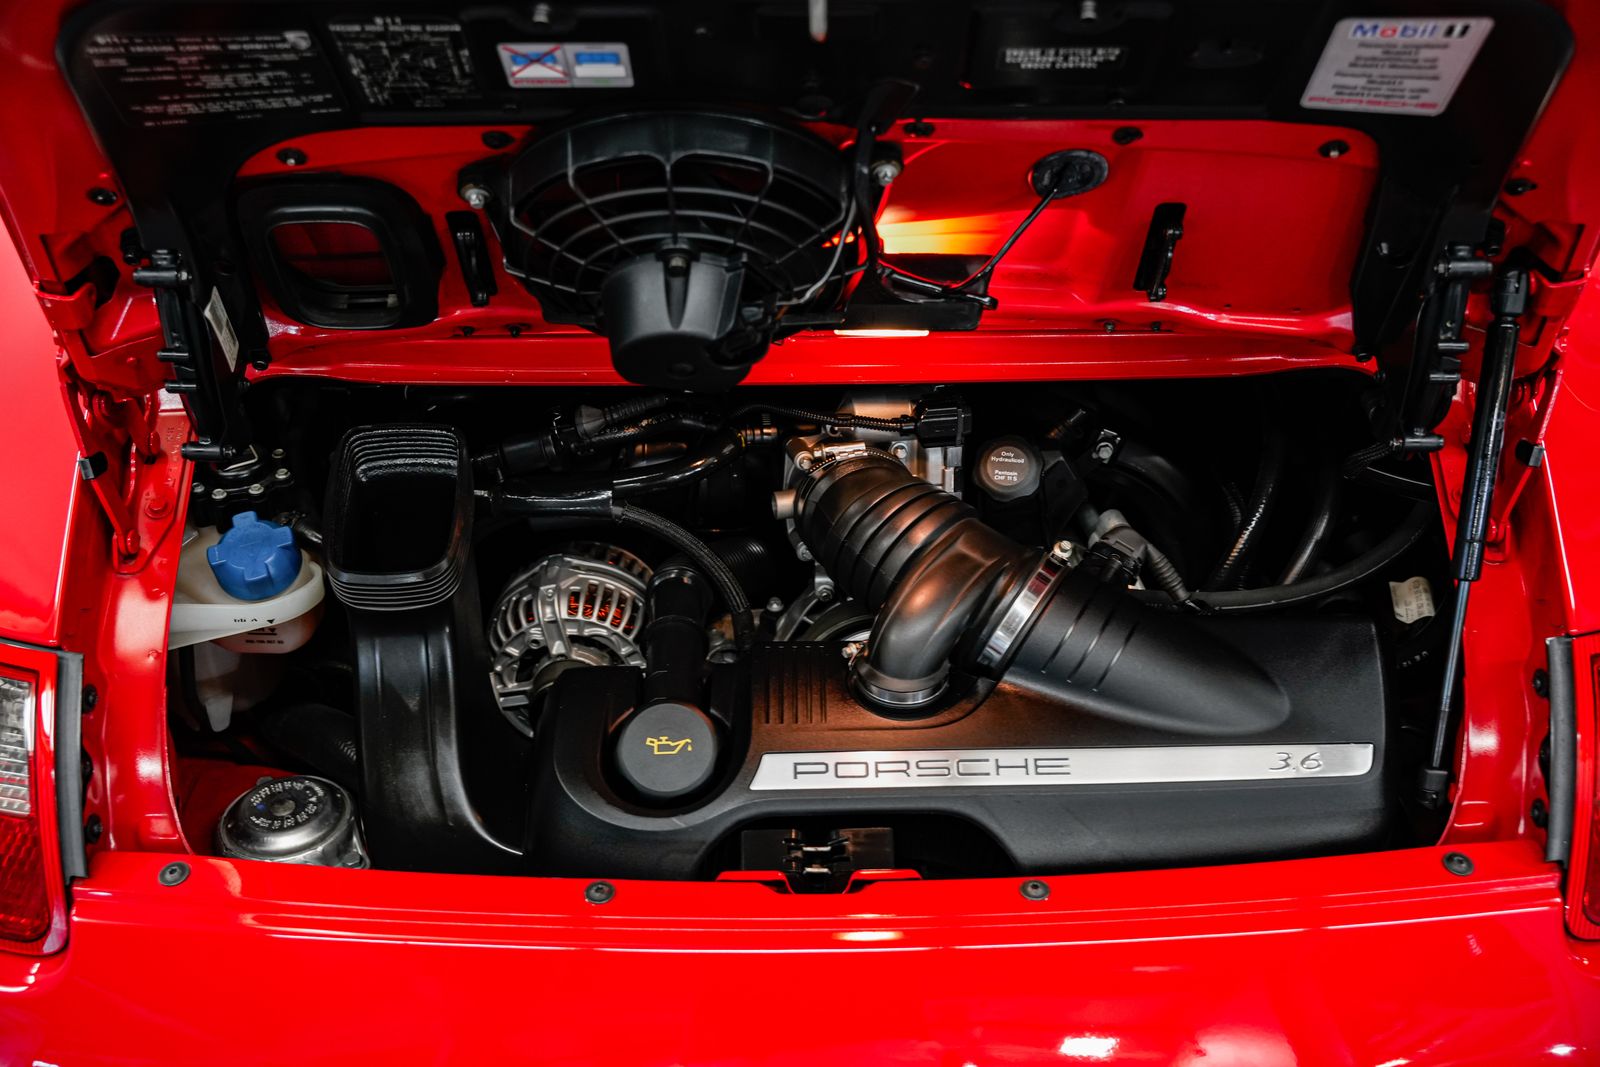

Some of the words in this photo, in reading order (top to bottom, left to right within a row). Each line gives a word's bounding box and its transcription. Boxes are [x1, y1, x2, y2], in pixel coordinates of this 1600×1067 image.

[1352, 23, 1438, 38] Mobil
[1307, 95, 1440, 110] PORSCHE
[1001, 450, 1015, 458] Only
[793, 757, 1072, 780] PORSCHE
[1268, 751, 1323, 771] 3.6
